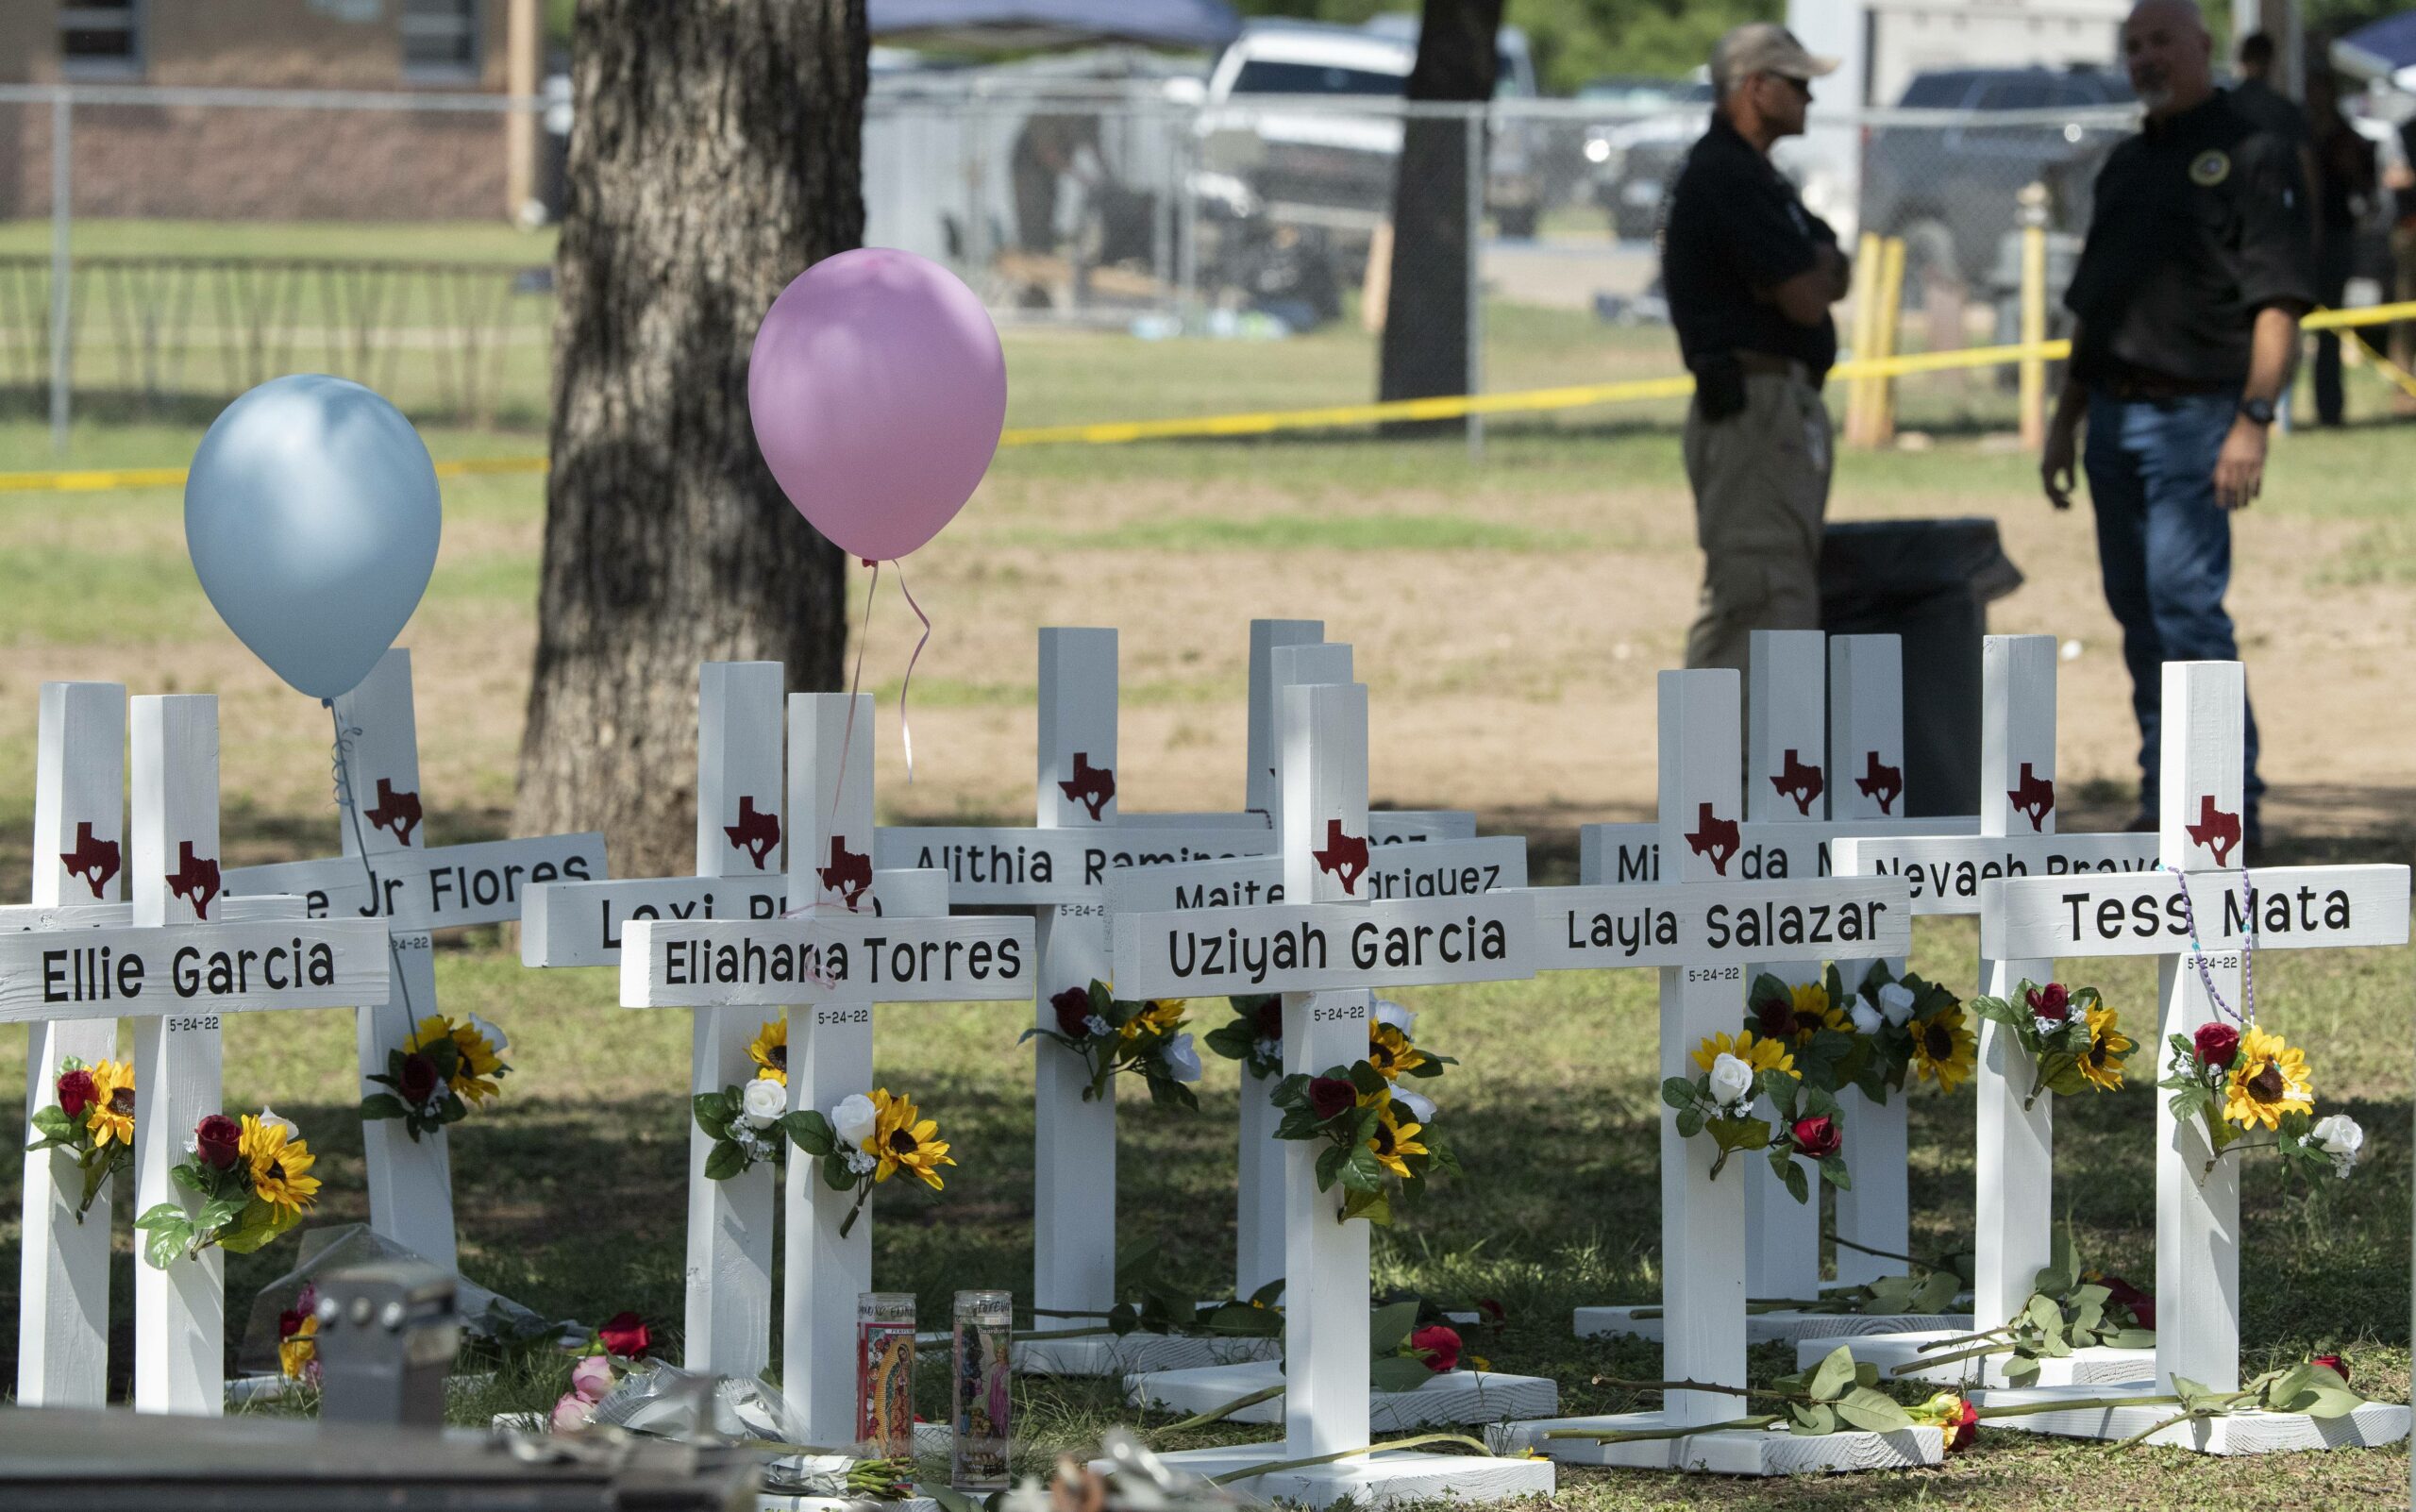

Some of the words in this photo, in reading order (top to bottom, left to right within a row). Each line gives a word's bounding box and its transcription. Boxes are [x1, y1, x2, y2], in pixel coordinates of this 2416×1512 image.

[916, 845, 1053, 884] Alithia
[1617, 843, 1789, 883] Mida
[358, 869, 405, 917] Jr
[428, 854, 592, 913] Flores
[1060, 904, 1105, 917] 5-24-2
[1568, 907, 1679, 958] Layla
[1705, 899, 1888, 950] Salazar
[2062, 892, 2194, 942] Tess
[2223, 885, 2351, 937] Mata
[665, 936, 849, 985] Eliahana
[863, 936, 1022, 983] Torres
[1168, 920, 1328, 984] Uziyah
[1351, 914, 1507, 971] Garcia
[2187, 955, 2239, 970] 5-24-22
[42, 945, 146, 1004] Ellie
[171, 936, 336, 999] Garcia
[1687, 966, 1740, 983] 5-24-22
[169, 1016, 220, 1033] 5-24-22
[817, 1009, 869, 1025] 5-24-22
[1313, 1004, 1366, 1022] 5-24-22
